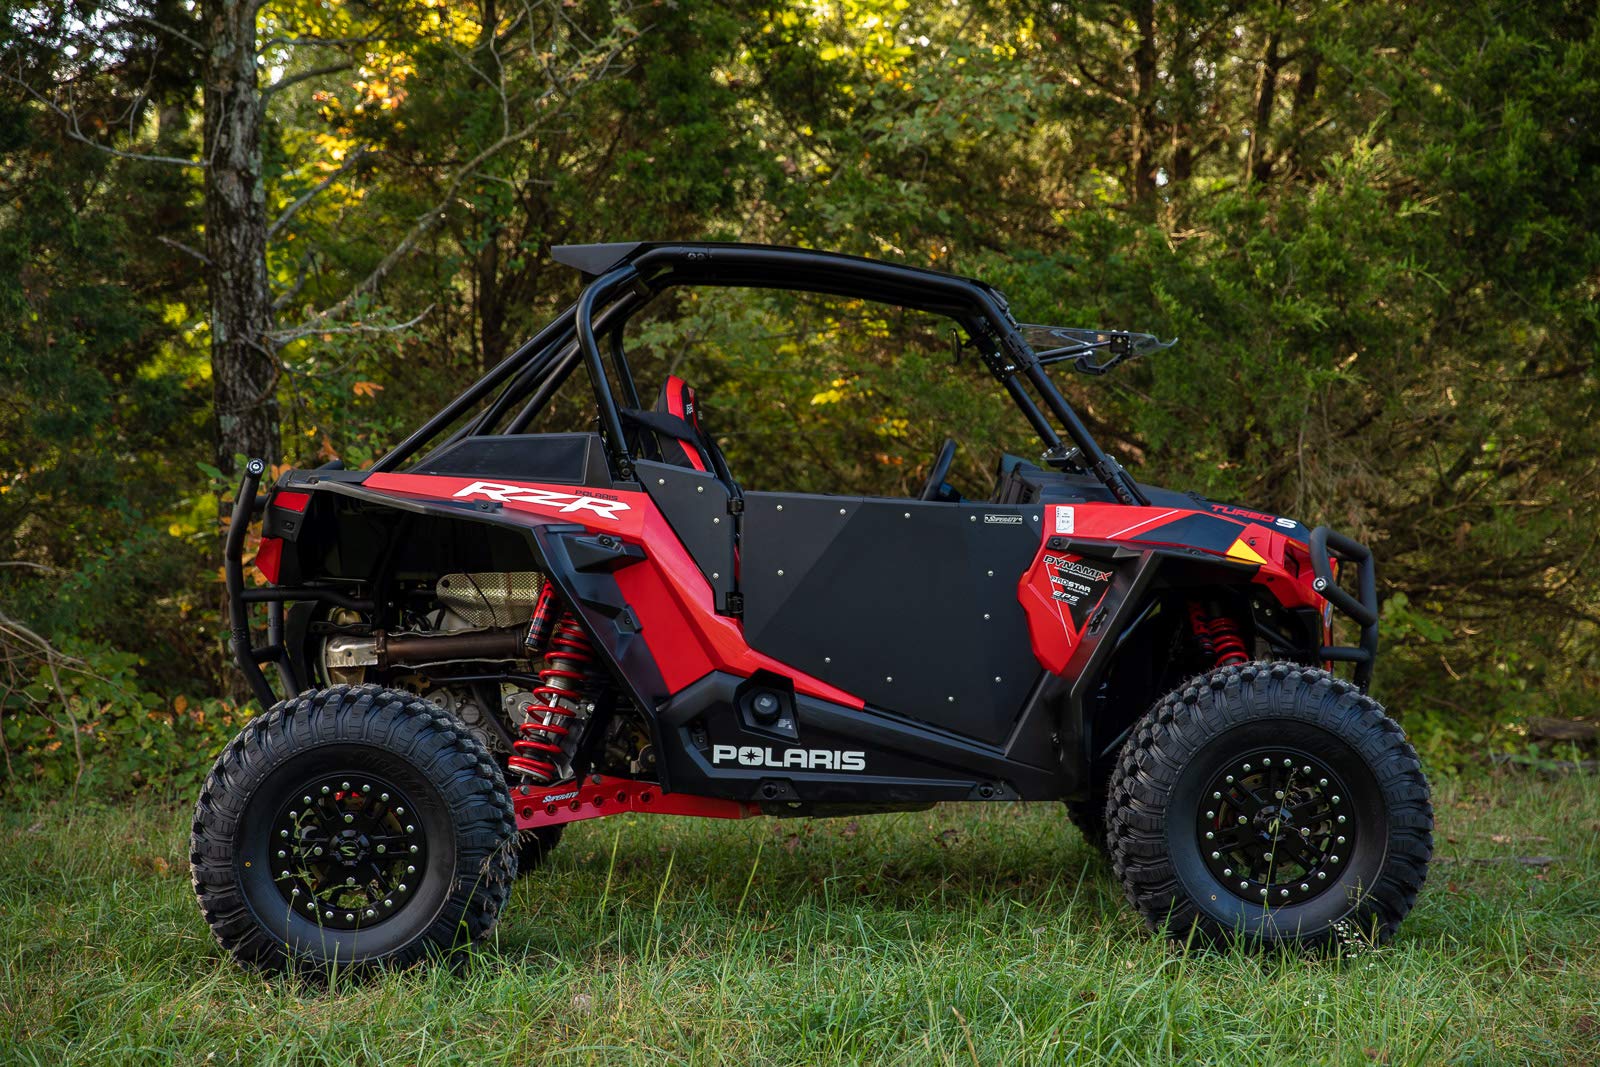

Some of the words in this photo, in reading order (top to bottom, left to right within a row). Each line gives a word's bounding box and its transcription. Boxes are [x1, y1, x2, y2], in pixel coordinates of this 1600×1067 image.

[452, 481, 632, 521] RZR
[575, 489, 619, 501] POLARIS
[1211, 504, 1276, 523] TURBO
[1275, 517, 1298, 529] S
[1043, 554, 1113, 582] DYNAMIX
[1050, 575, 1092, 593] PROSTAR
[712, 744, 866, 771] POLARIS
